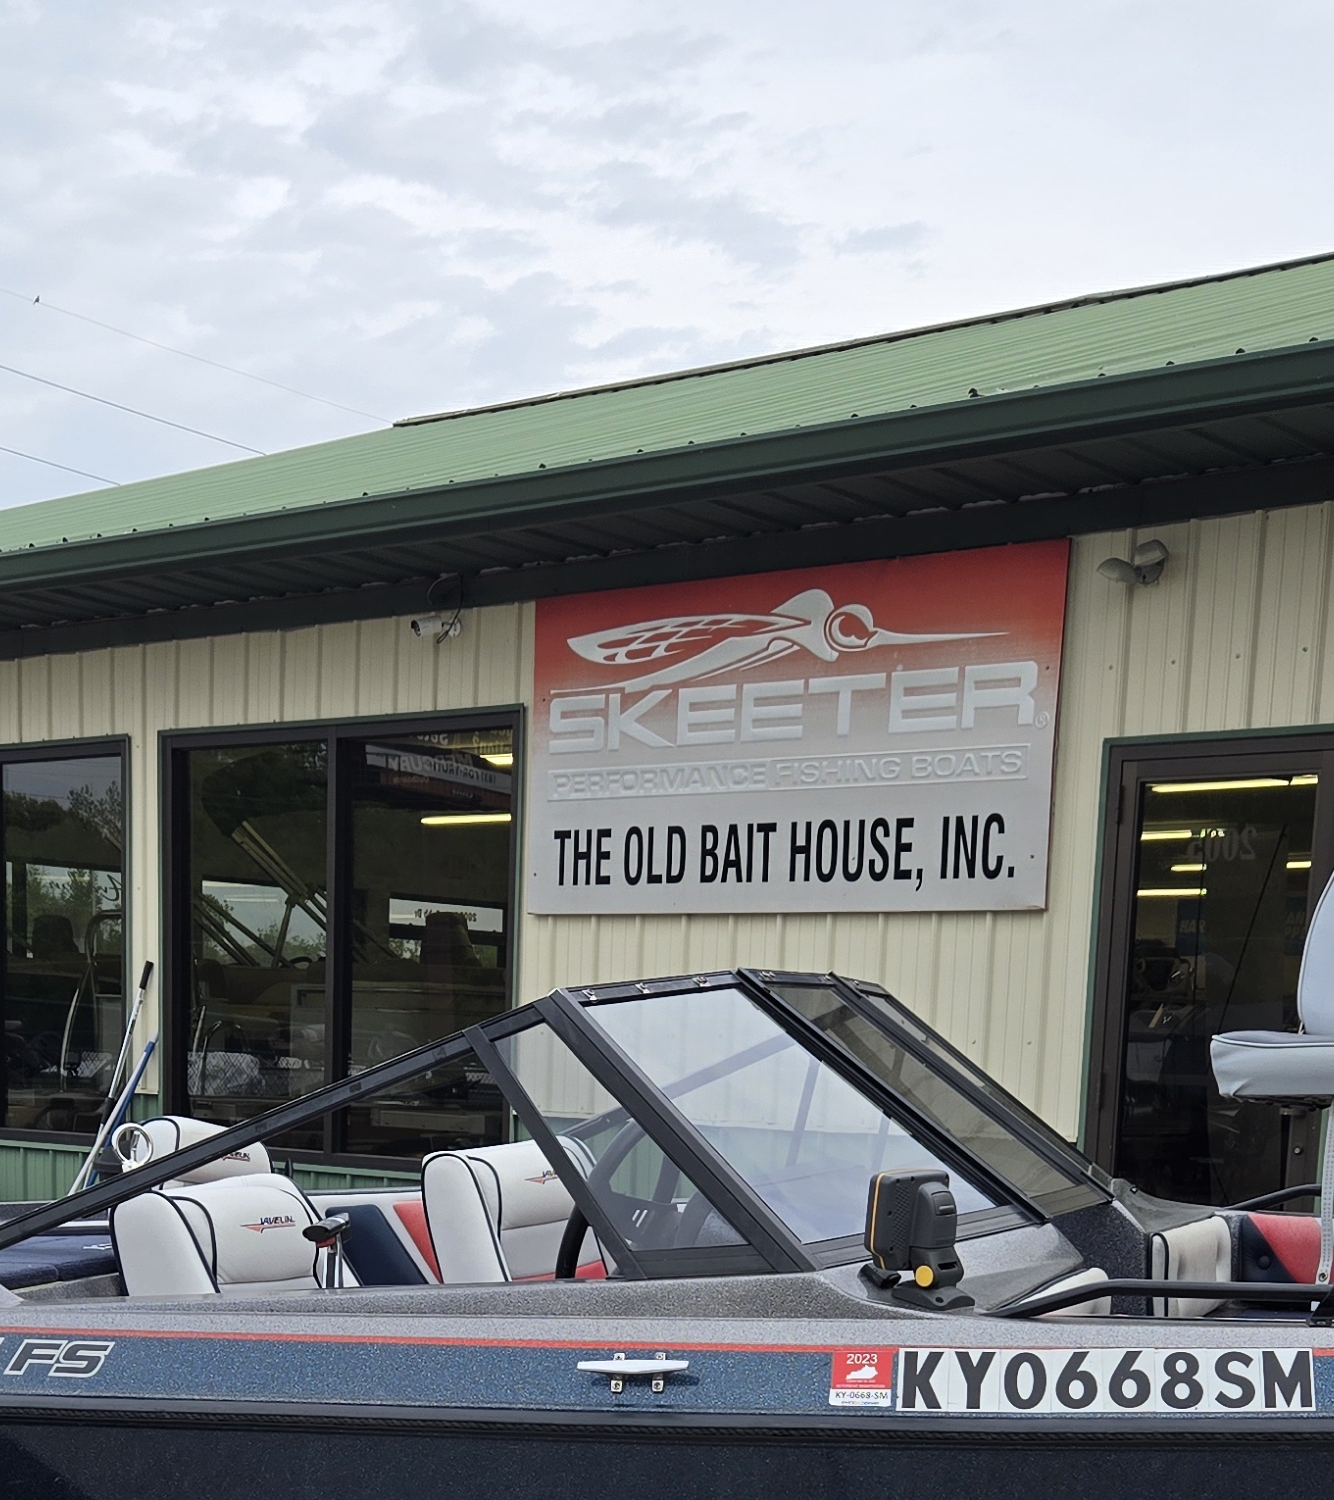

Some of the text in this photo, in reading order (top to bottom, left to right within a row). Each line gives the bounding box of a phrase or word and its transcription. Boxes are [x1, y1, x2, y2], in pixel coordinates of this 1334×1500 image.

[549, 660, 1038, 754] SKEETER
[554, 750, 1023, 797] PERFORMANCE FISHING BOATS
[553, 812, 1015, 892] THE OLD BAIT HOUSE, INC.
[260, 1215, 295, 1226] JAVELIN
[3, 1339, 116, 1379] FS
[845, 1352, 878, 1365] 2023
[901, 1350, 1313, 1410] KY0668SM
